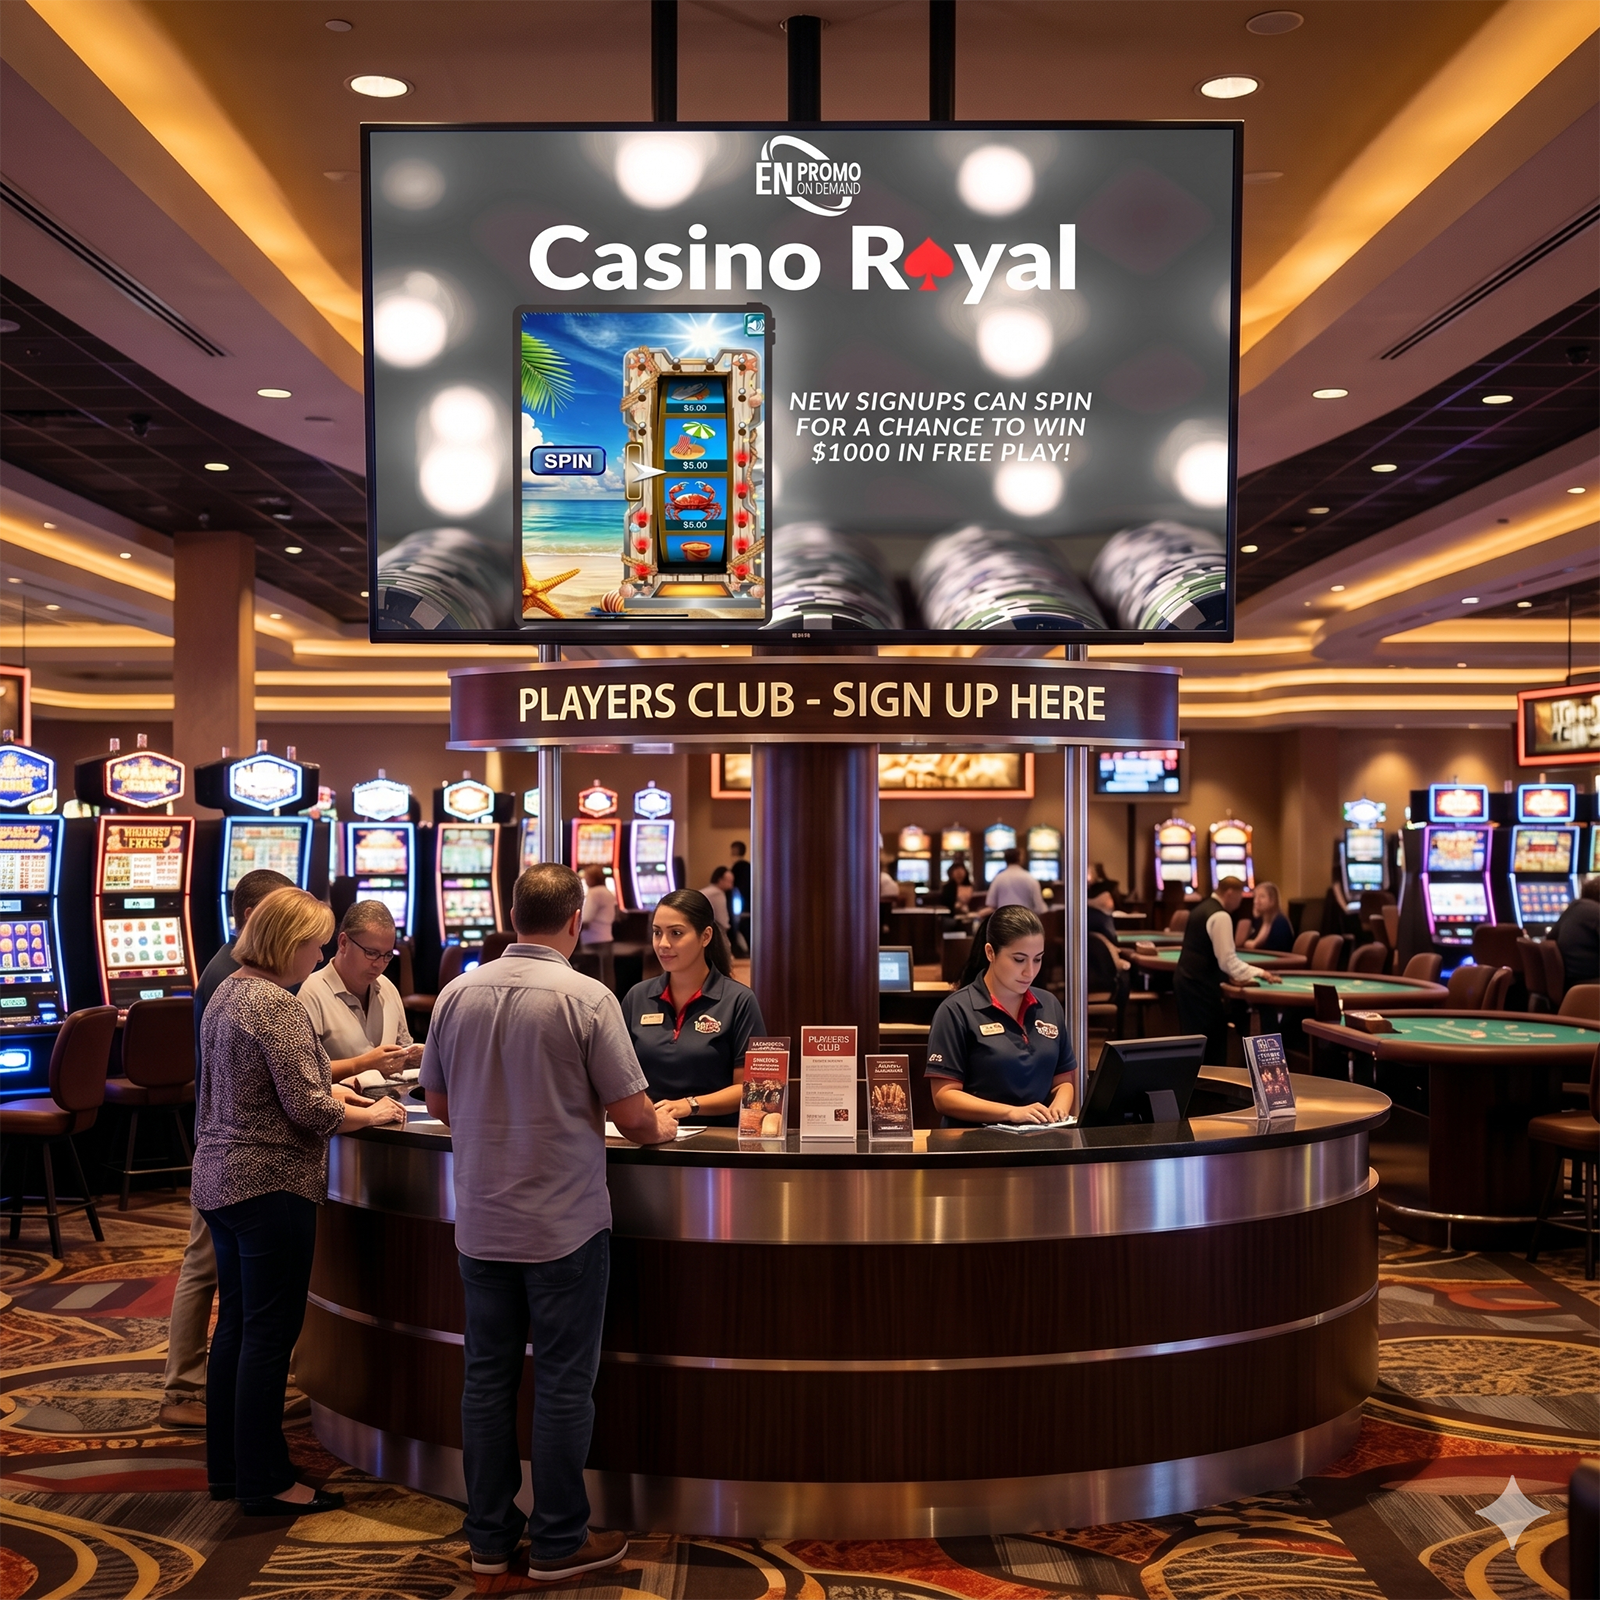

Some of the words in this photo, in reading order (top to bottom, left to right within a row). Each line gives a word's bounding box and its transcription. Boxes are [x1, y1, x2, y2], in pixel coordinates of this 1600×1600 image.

[756, 162, 793, 195] EN
[797, 162, 861, 181] PROMO
[797, 182, 813, 195] ON
[816, 182, 861, 195] DEMAND
[528, 223, 821, 291] Casino
[851, 223, 1076, 305] Ryal
[789, 391, 850, 411] NEW
[855, 391, 967, 411] SIGNUPS
[973, 391, 1027, 411] CAN
[1033, 391, 1093, 411] SPIN
[795, 417, 847, 436] FOR
[853, 417, 871, 436] A
[878, 417, 984, 436] CHANCE
[992, 417, 1026, 436] TO
[1033, 417, 1086, 436] WIN
[544, 453, 593, 469] SPIN
[811, 441, 890, 464] $1000
[898, 443, 925, 462] IN
[932, 443, 994, 462] FREE
[1000, 443, 1070, 462] PLAY!
[682, 461, 708, 470] $5.00
[682, 520, 707, 529] $5.00
[519, 683, 676, 722] PLAYERS
[687, 682, 795, 718] CLUB
[833, 682, 930, 718] SIGN
[945, 682, 999, 718] UP
[1011, 683, 1106, 721] HERE
[817, 1043, 840, 1052] CLUB
